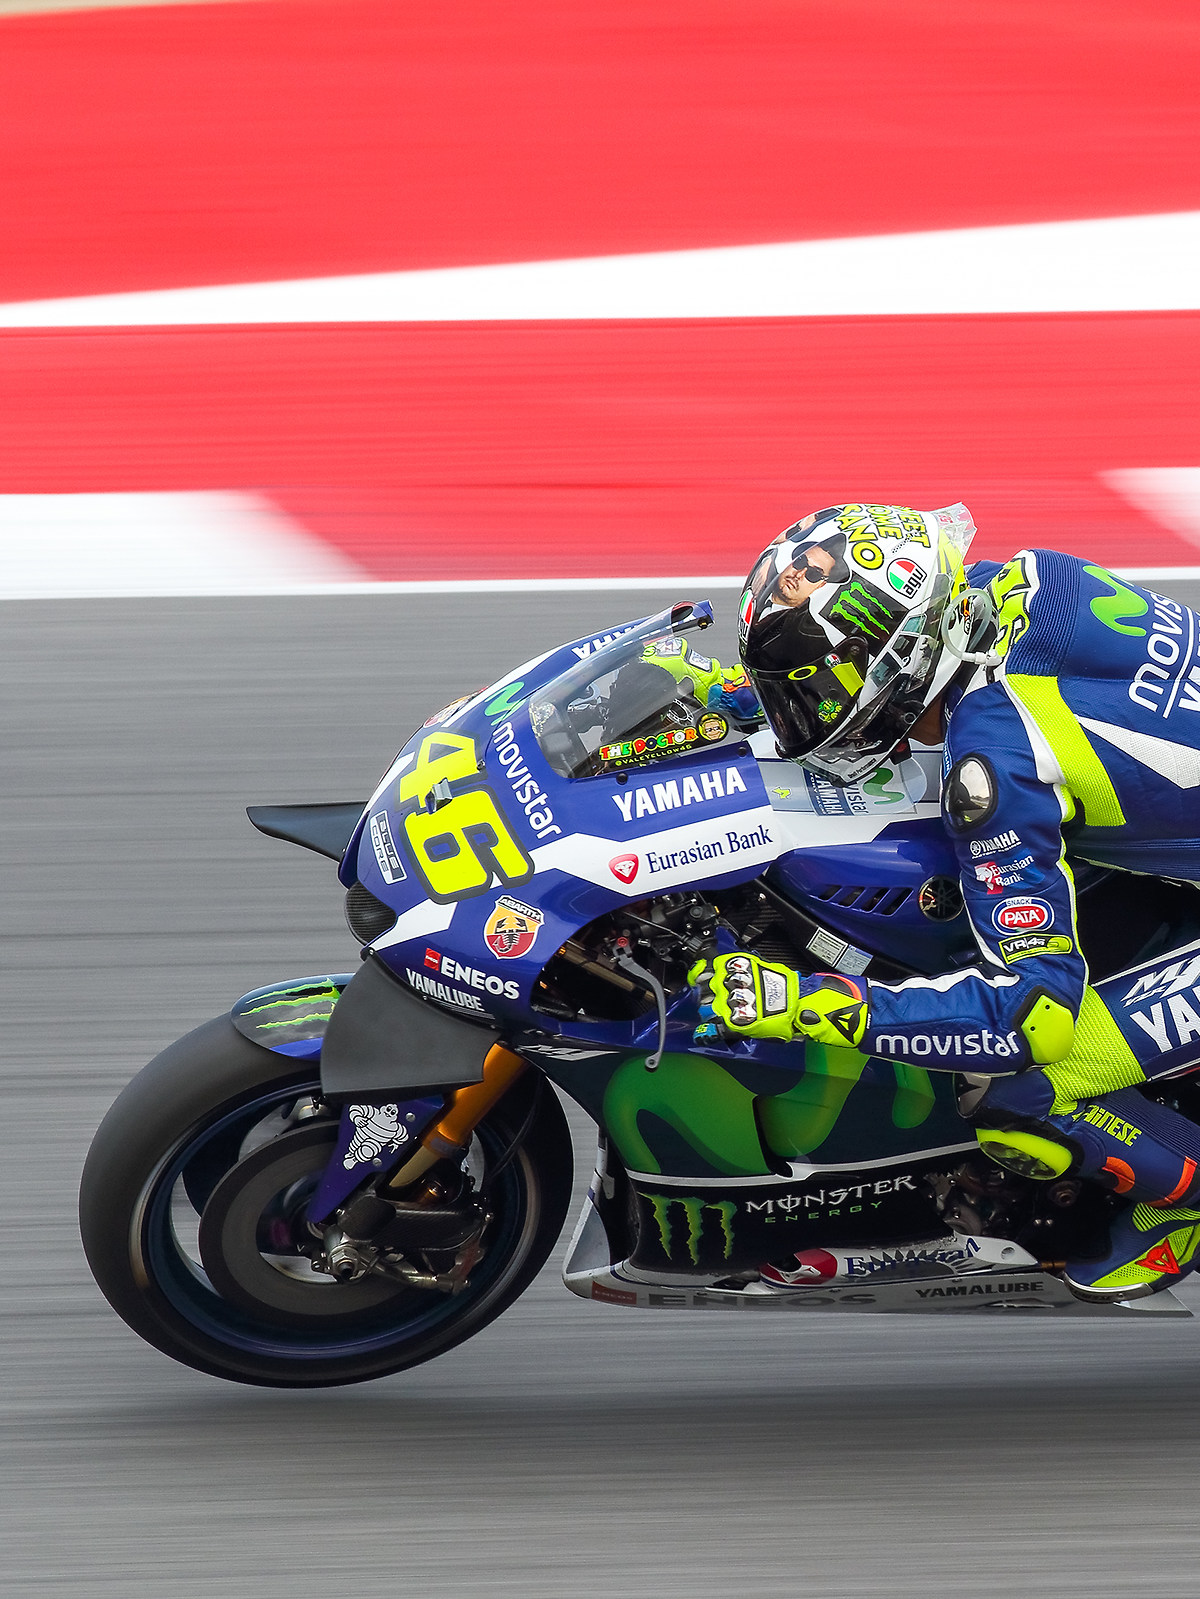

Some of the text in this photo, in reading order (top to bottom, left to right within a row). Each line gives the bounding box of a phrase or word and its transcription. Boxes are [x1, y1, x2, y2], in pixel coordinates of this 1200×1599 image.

[866, 504, 904, 540] OME
[893, 505, 931, 548] WEET
[903, 568, 923, 595] agv
[1128, 588, 1184, 712] movis
[599, 727, 698, 760] THE DOCTOR
[493, 721, 562, 839] movistar
[612, 766, 747, 822] YAMAHA
[399, 731, 530, 896] 46
[372, 825, 389, 873] CORE
[379, 818, 400, 871] BLUE
[645, 824, 774, 874] Eurasian Bank
[979, 830, 1020, 853] YAMAHA
[990, 855, 1035, 876] Eurasian
[501, 896, 542, 920] ABARTH
[1004, 909, 1040, 925] PATA
[406, 968, 485, 1012] YAMALUBE
[441, 956, 520, 1000] ENEOS
[875, 1029, 1020, 1057] movistar
[1072, 1105, 1142, 1147] AINESE
[745, 1175, 917, 1214] MONSTER
[764, 1201, 882, 1223] ENERGY
[649, 1292, 876, 1307] ENEOS
[915, 1281, 1045, 1299] YAMALUBE
